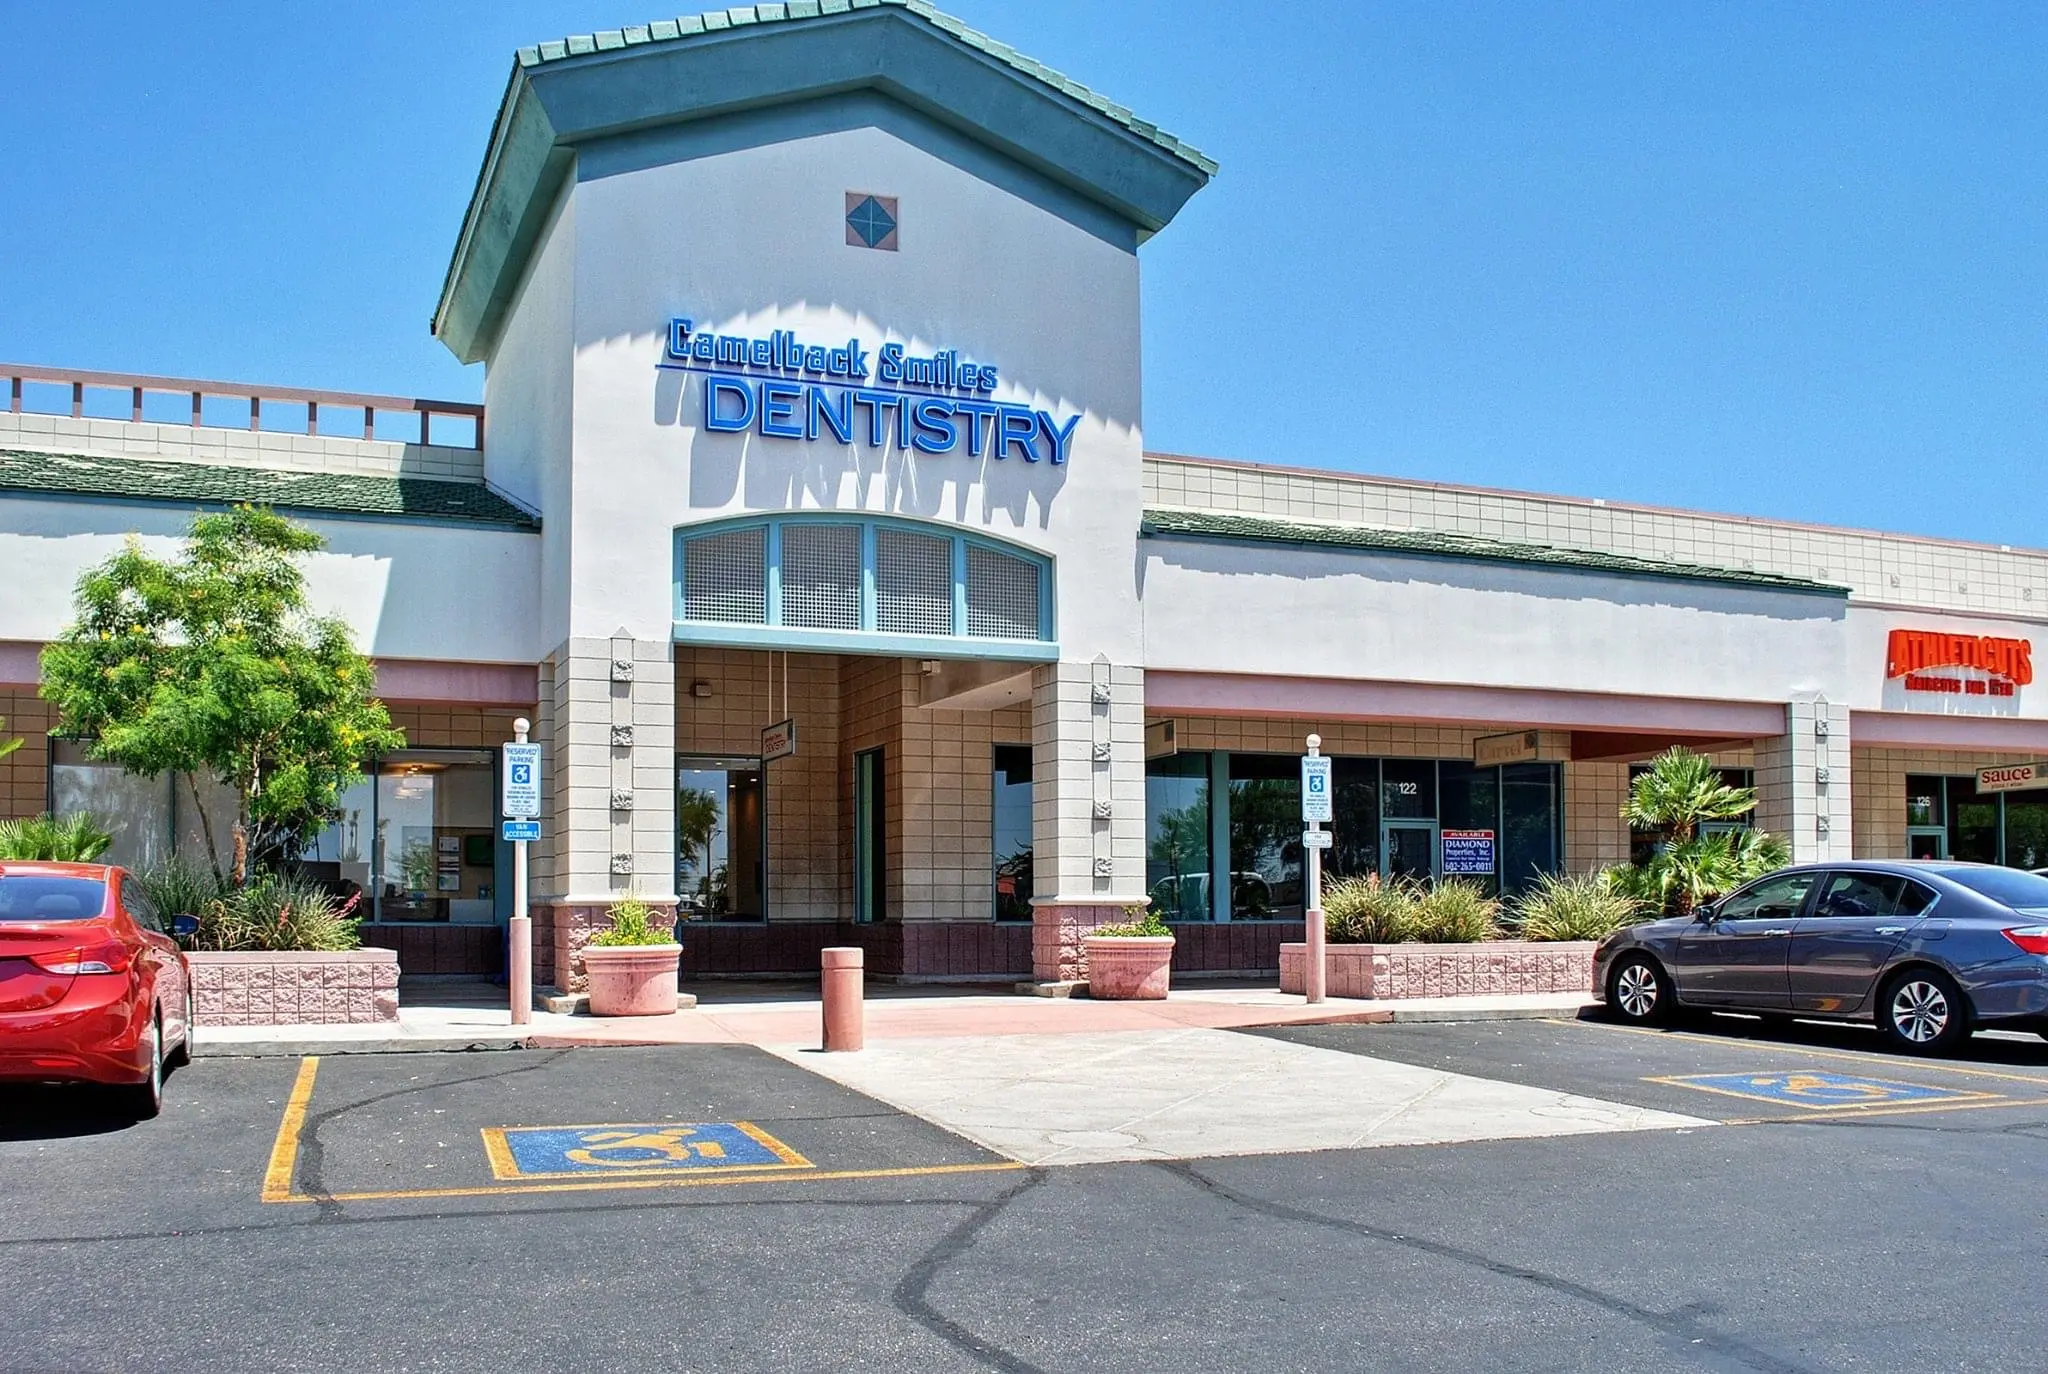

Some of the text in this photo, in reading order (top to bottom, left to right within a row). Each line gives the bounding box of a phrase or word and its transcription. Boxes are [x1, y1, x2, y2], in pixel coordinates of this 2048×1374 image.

[667, 317, 998, 393] Camelback Smiles
[705, 375, 1083, 465] DENTISTRY
[1888, 629, 2033, 686] ATHLETICUTS
[1399, 782, 1417, 795] 122
[1982, 767, 2032, 783] sauce
[1445, 840, 1490, 848] DIAMOND
